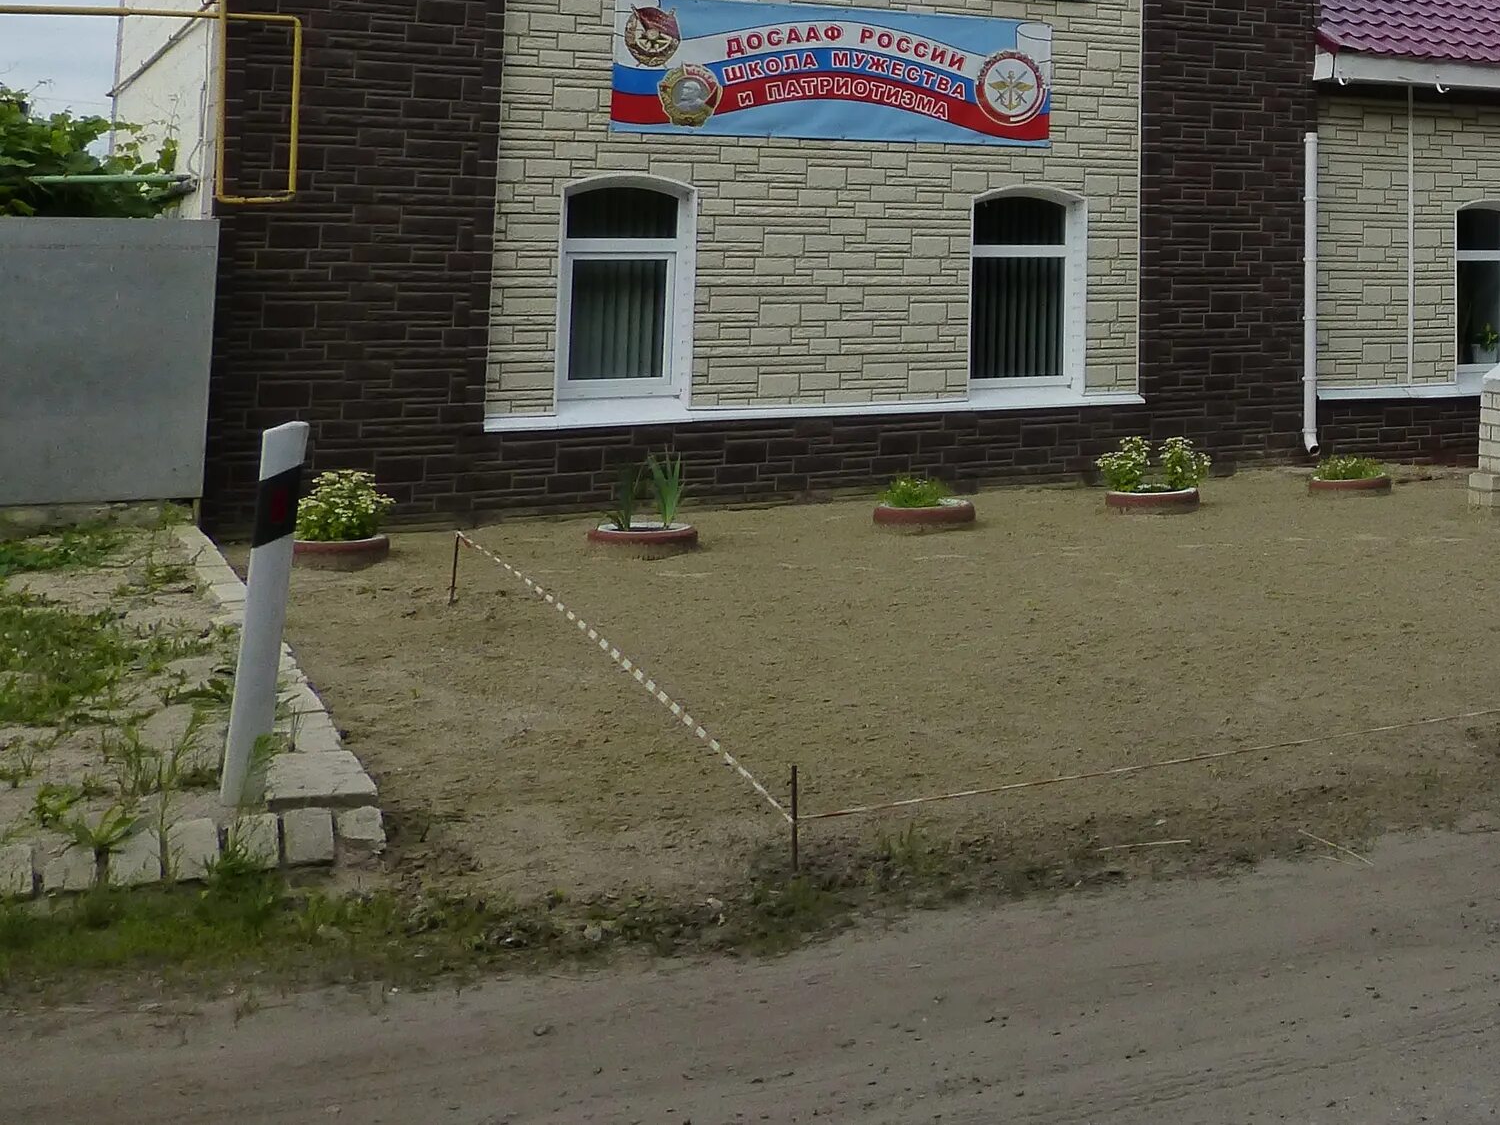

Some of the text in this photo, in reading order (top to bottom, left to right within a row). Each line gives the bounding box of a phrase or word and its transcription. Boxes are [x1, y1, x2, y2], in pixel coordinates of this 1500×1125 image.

[725, 23, 967, 72] ДОСААФ РОССИИ
[722, 51, 818, 85] ШКОЛА
[832, 52, 967, 101] МУЖЕСТВА
[766, 76, 949, 121] ПАТРИОТИЗМА
